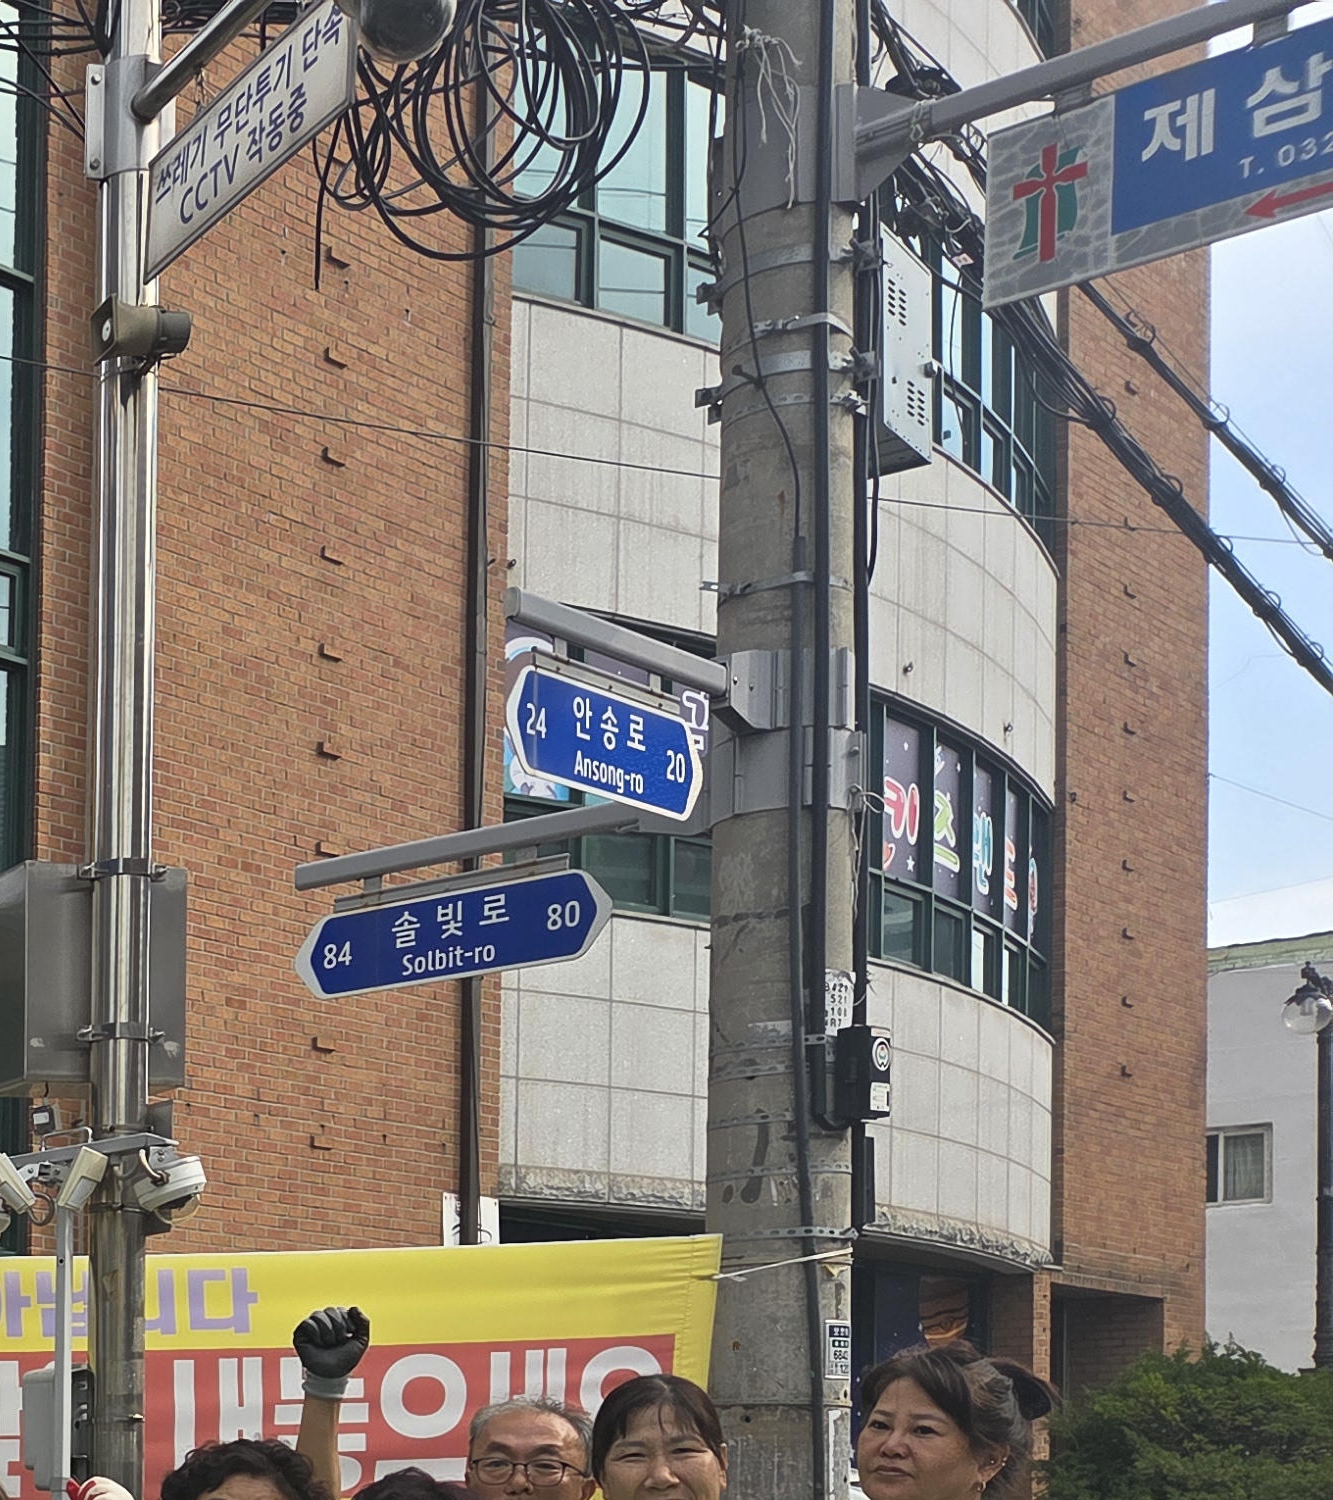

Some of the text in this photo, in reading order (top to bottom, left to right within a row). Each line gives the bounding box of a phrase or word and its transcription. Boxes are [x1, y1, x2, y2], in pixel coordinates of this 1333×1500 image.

[156, 125, 208, 205] 쓰레기
[213, 44, 293, 149] 무단투기
[180, 82, 308, 224] CCTV 작동중
[526, 702, 547, 739] 24
[572, 697, 646, 751] 안송로
[665, 750, 686, 783] 20
[574, 749, 644, 795] Ansong-ro
[323, 894, 581, 970] 84 솔빛로 80
[402, 943, 495, 977] Solbit-ro
